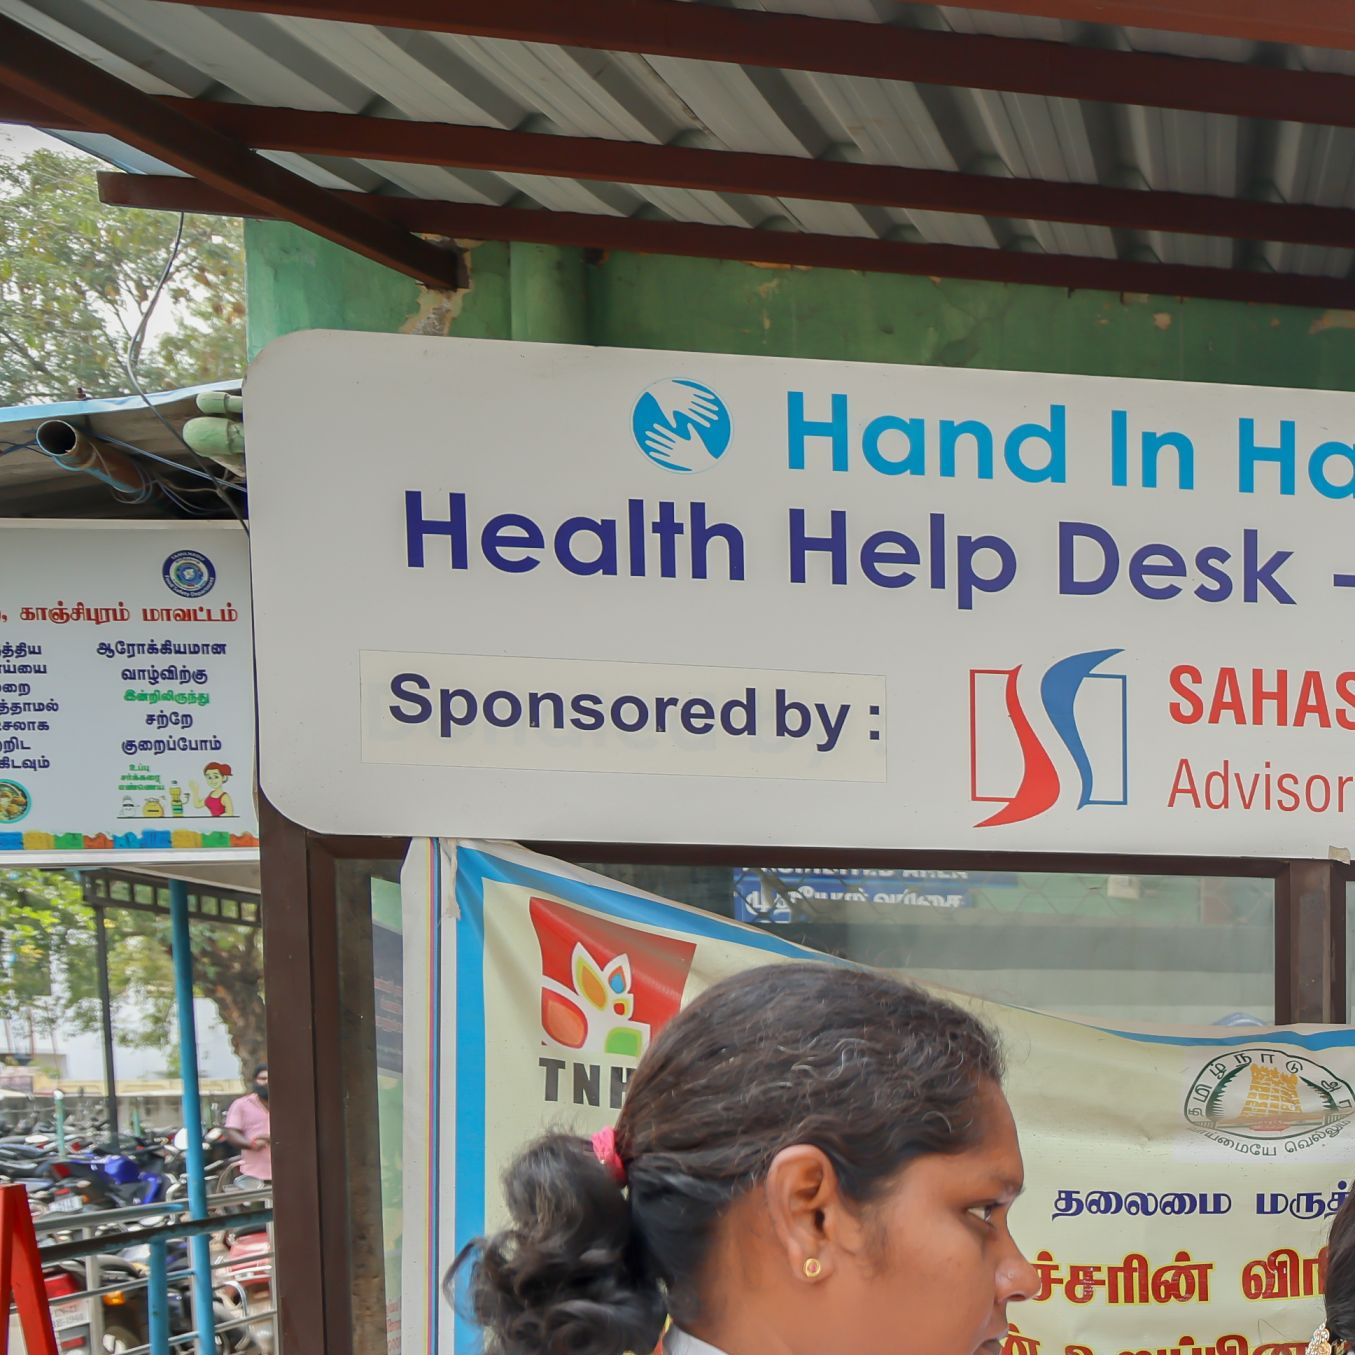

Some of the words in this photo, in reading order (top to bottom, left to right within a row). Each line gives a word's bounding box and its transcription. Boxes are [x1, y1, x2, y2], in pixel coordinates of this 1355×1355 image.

[787, 391, 1066, 485] Hand
[1110, 409, 1195, 490] In
[404, 490, 745, 581] Health
[789, 508, 1017, 611] Help
[1058, 520, 1297, 602] Desk
[20, 600, 130, 625] காஞ்சிபுரம்
[142, 602, 239, 622] மாவட்டம்
[97, 640, 227, 658] ஆரோக்கியமான
[121, 665, 208, 685] வாழ்விற்கு
[145, 710, 193, 729] சற்றே
[388, 672, 758, 740] Sponsored
[775, 687, 849, 752] by
[121, 735, 222, 755] குறைப்போம்
[1052, 1190, 1232, 1221] தலைமை
